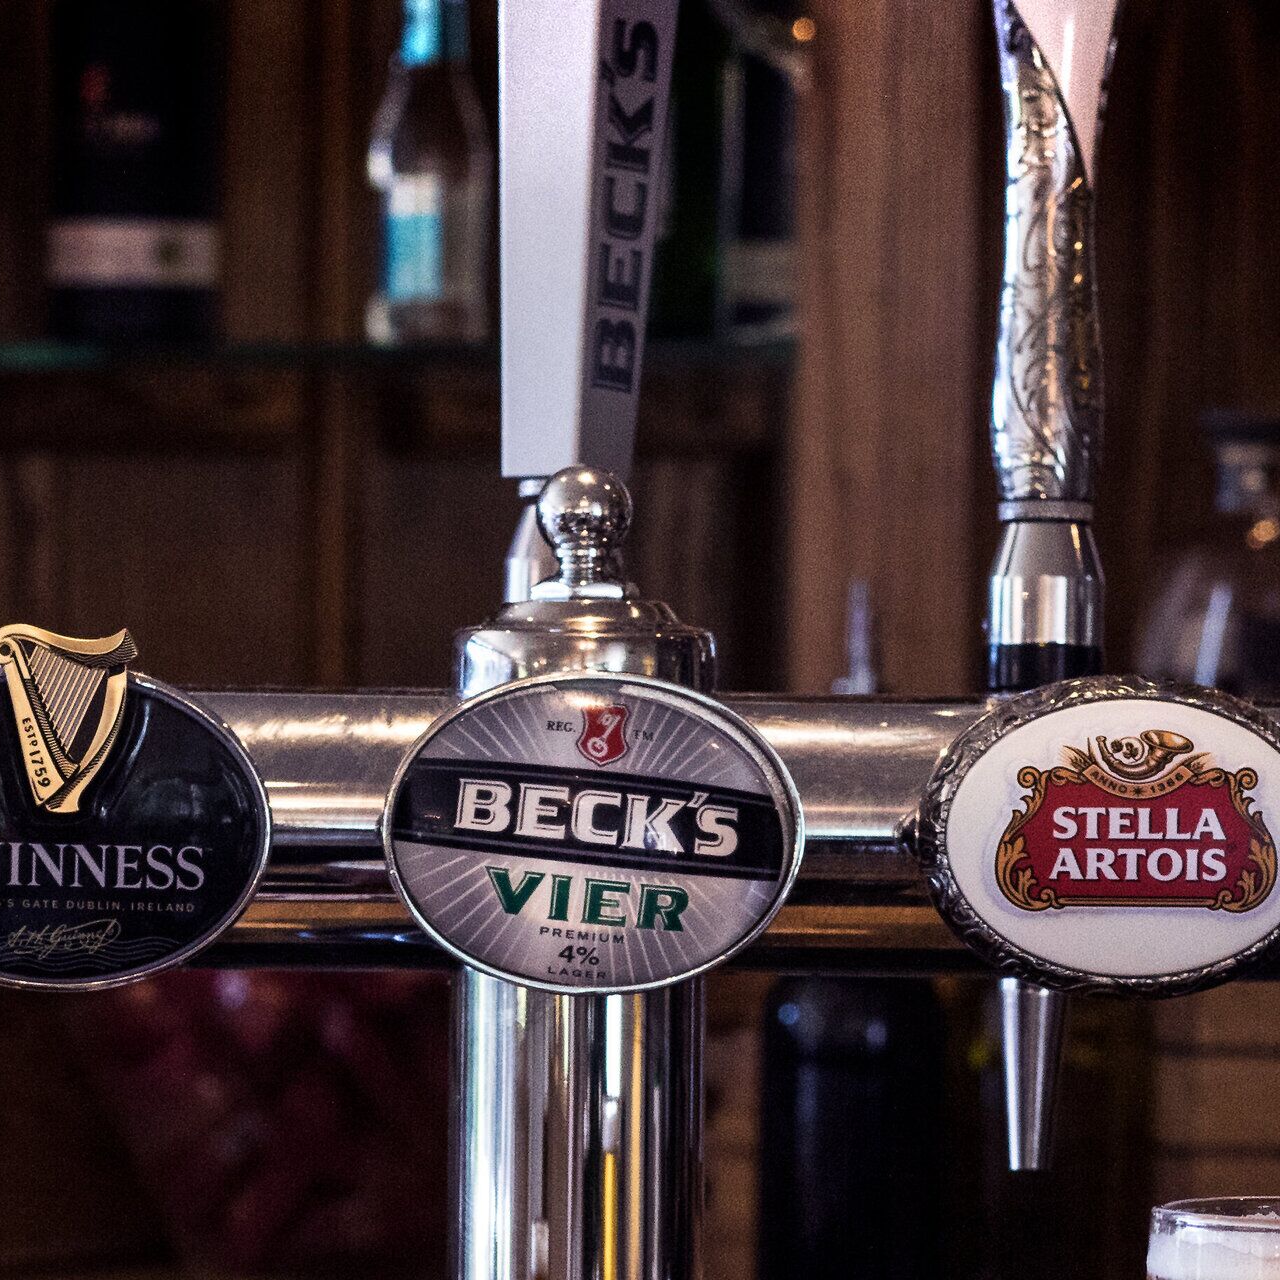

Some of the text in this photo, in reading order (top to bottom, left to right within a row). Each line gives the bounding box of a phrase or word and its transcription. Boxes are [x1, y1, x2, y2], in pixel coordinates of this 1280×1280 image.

[593, 19, 659, 393] BECK'S
[546, 720, 575, 732] REG.
[29, 750, 51, 787] 1759
[1090, 771, 1127, 793] ANNO
[454, 778, 738, 856] BECK'S
[1052, 806, 1226, 841] STELLA
[1049, 847, 1228, 882] ARTOIS
[22, 899, 58, 909] GATE
[131, 902, 195, 912] IRELAND
[486, 866, 689, 932] VIER
[539, 926, 624, 943] PREMIUM
[558, 945, 599, 965] 4%
[548, 966, 606, 979] LAGER
